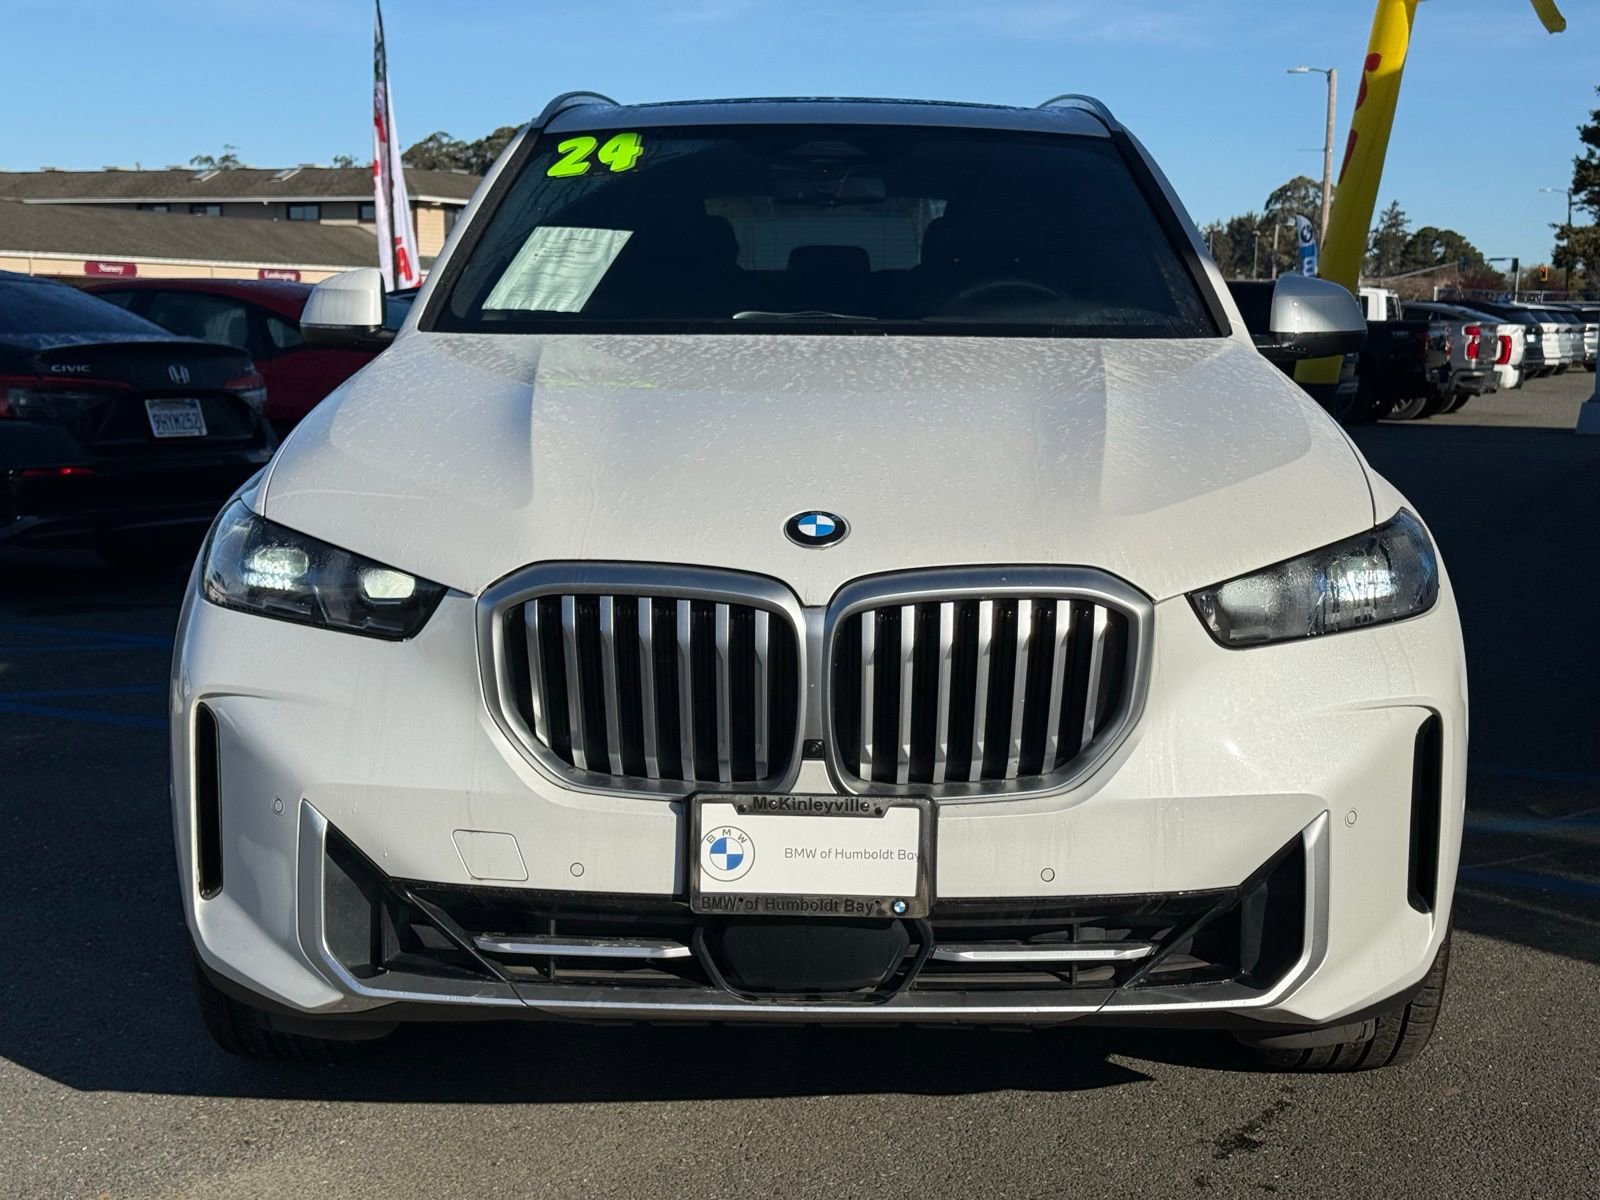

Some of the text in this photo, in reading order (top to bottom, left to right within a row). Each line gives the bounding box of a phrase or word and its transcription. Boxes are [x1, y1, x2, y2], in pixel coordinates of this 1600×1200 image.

[547, 132, 644, 178] 24
[51, 364, 92, 373] CIVIC
[752, 796, 871, 814] McKinleyville
[706, 828, 748, 844] BMW
[784, 847, 817, 859] BMW
[820, 847, 832, 860] of
[835, 848, 894, 861] Humboldt
[702, 896, 874, 916] BMW of Humboldt Bay
